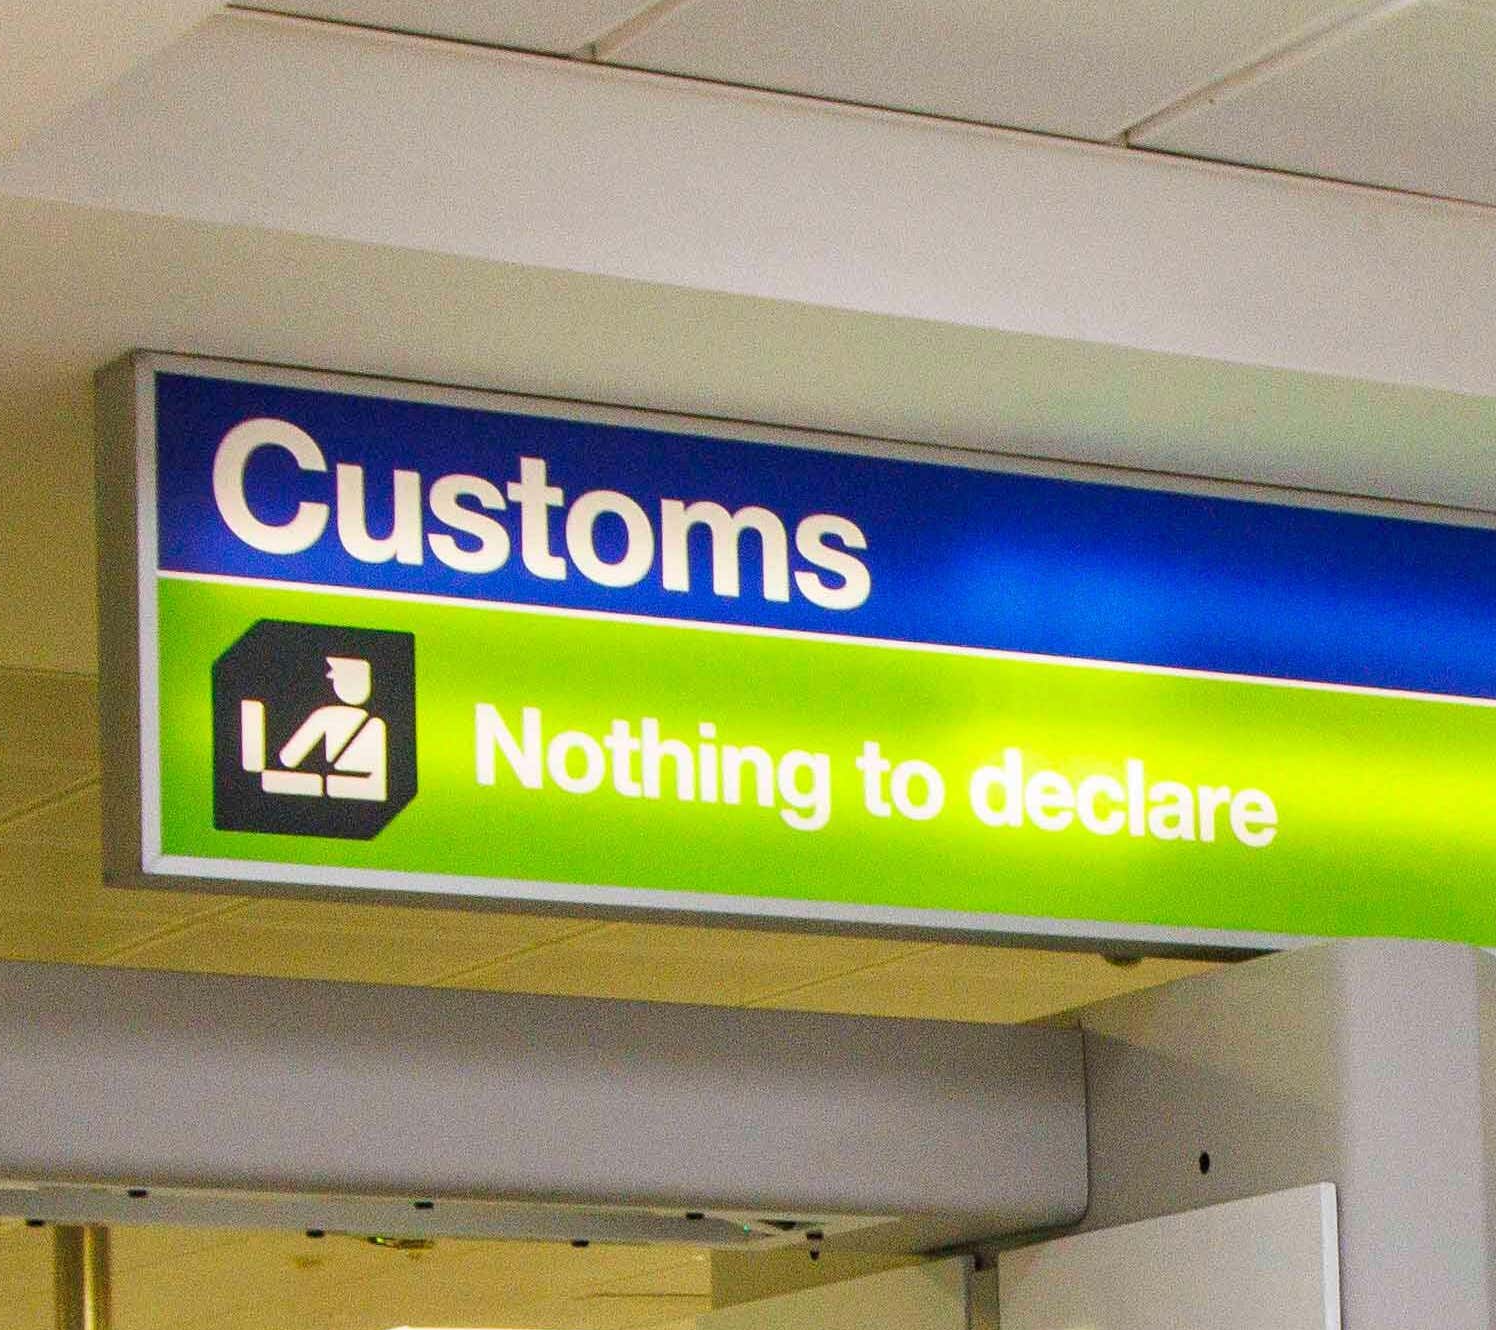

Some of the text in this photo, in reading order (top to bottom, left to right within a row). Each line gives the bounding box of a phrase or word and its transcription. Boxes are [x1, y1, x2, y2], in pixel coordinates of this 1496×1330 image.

[211, 417, 872, 611] Customs
[472, 701, 1279, 848] Nothing to declare
